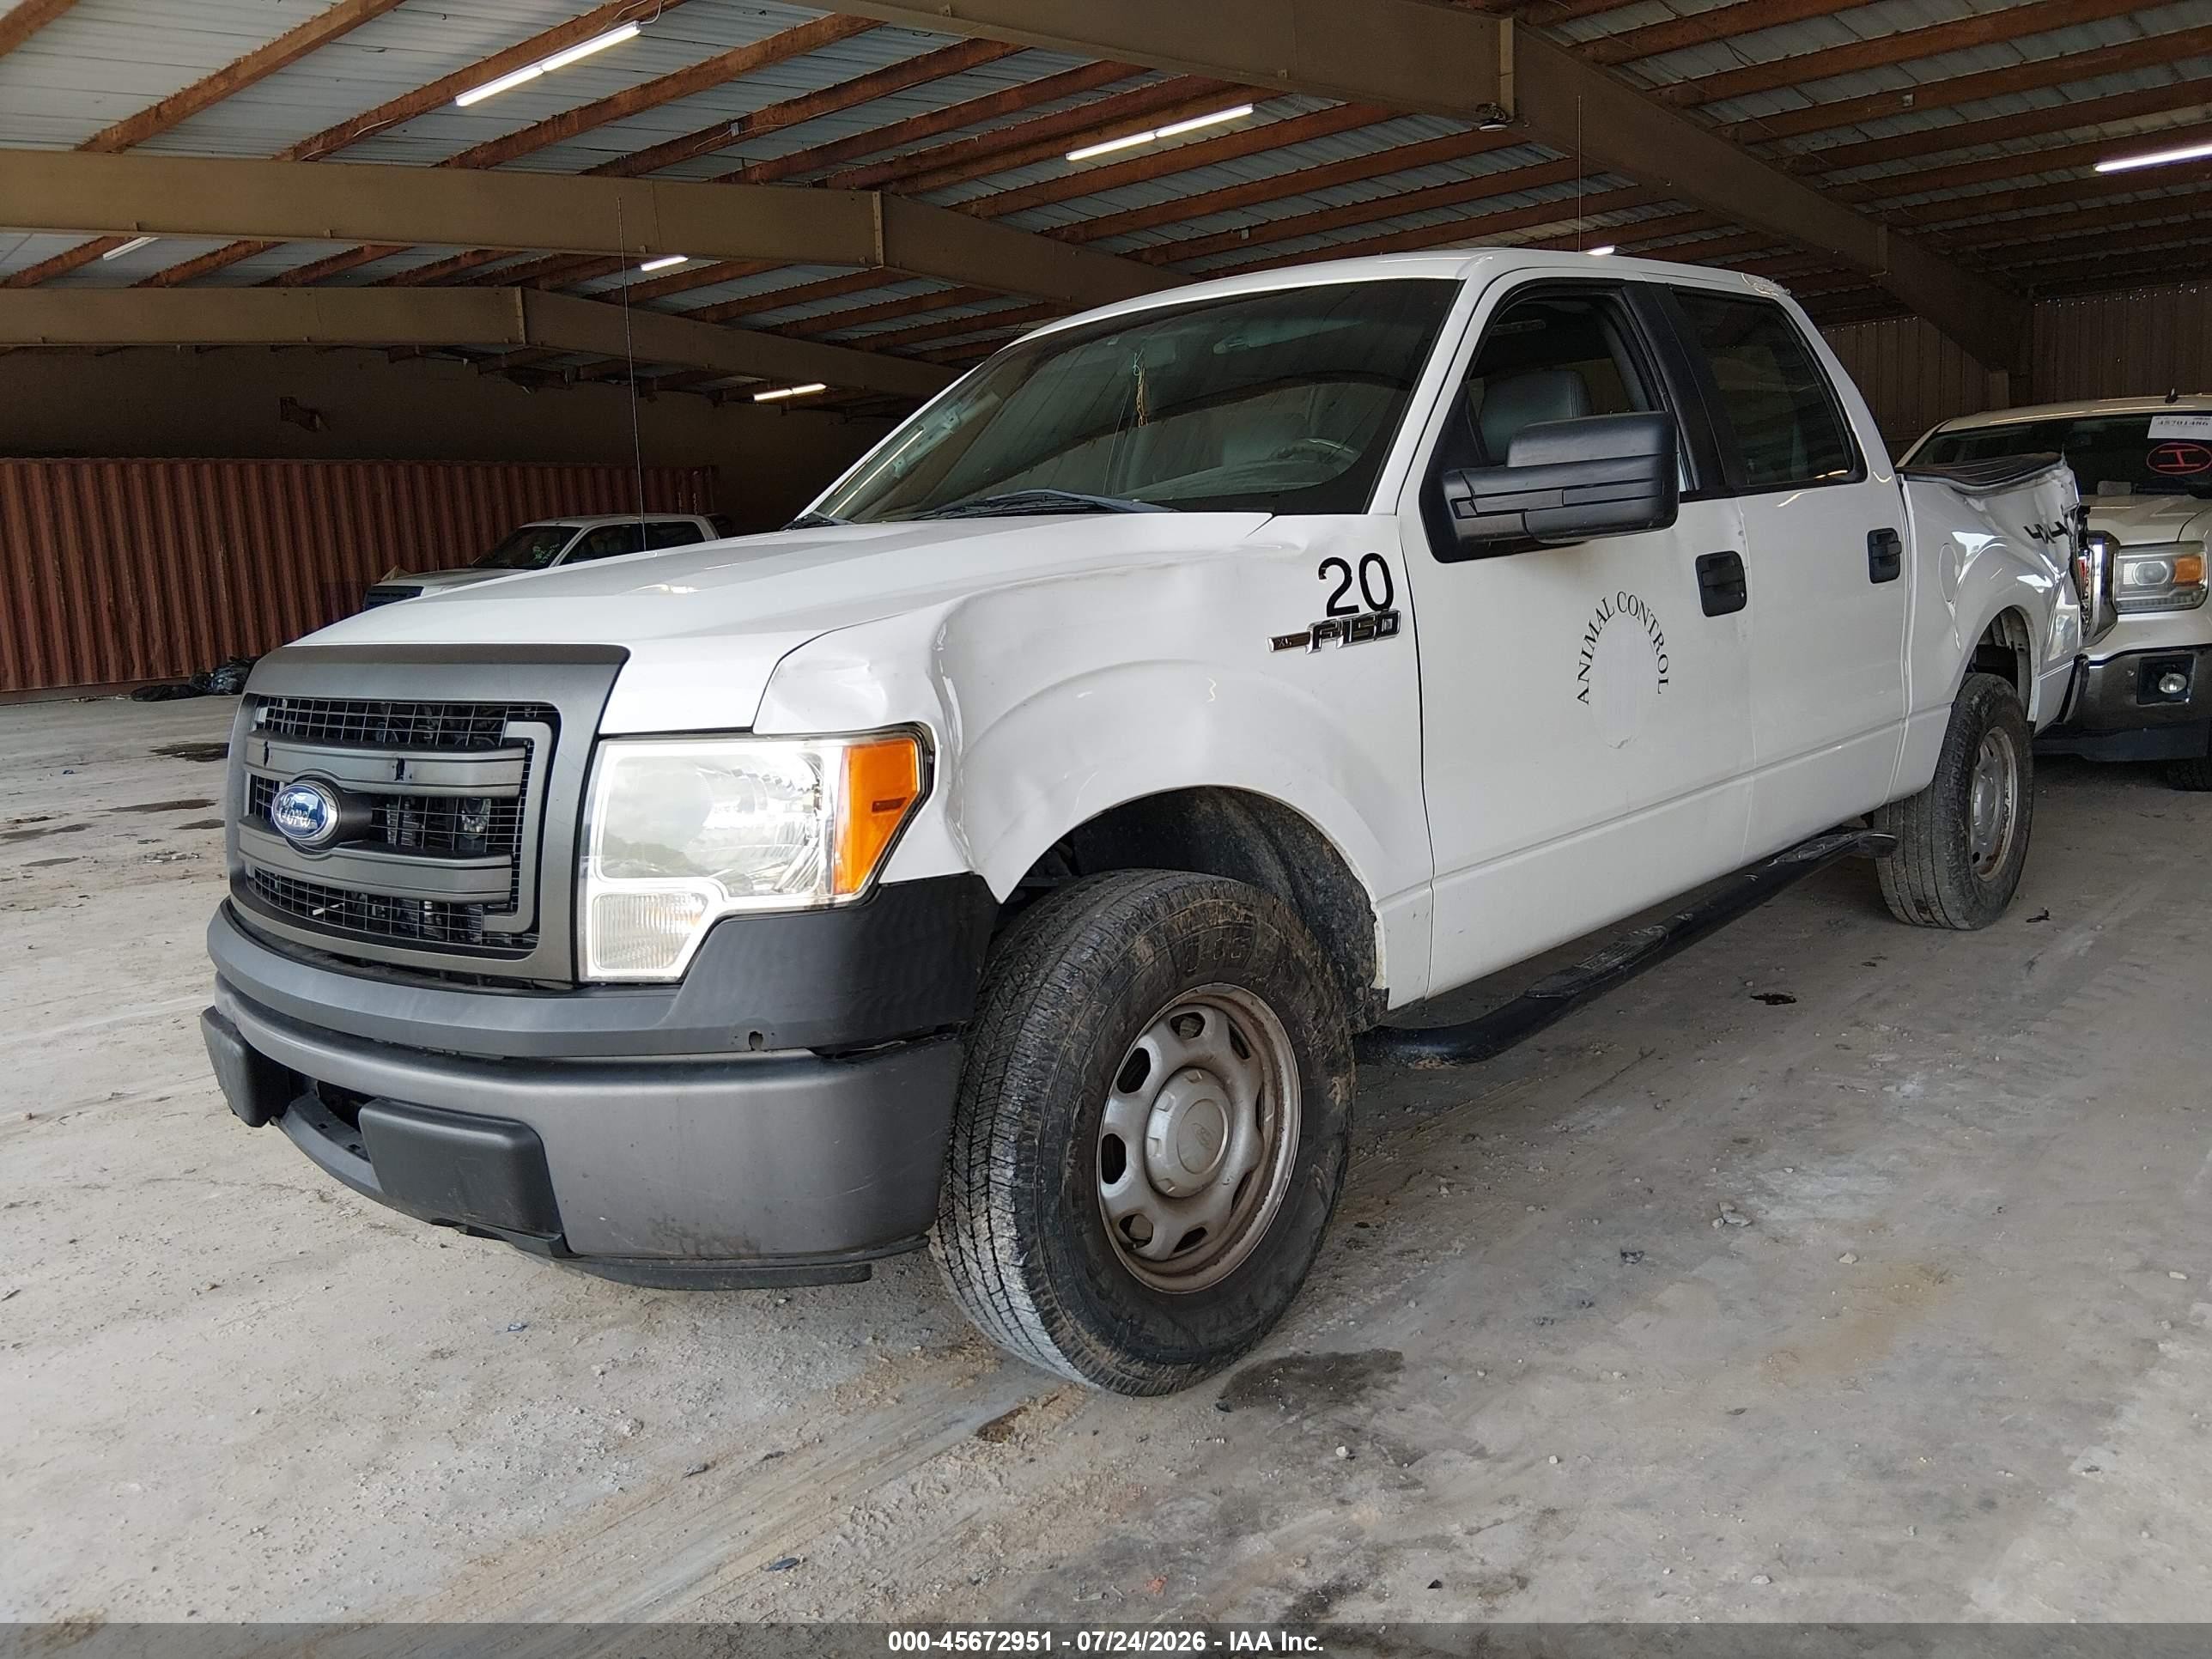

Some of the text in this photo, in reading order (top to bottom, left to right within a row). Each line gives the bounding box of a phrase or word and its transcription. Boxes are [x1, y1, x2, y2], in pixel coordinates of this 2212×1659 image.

[1318, 552, 1394, 617] 20
[1577, 591, 1669, 706] ANIMAL CONTROL
